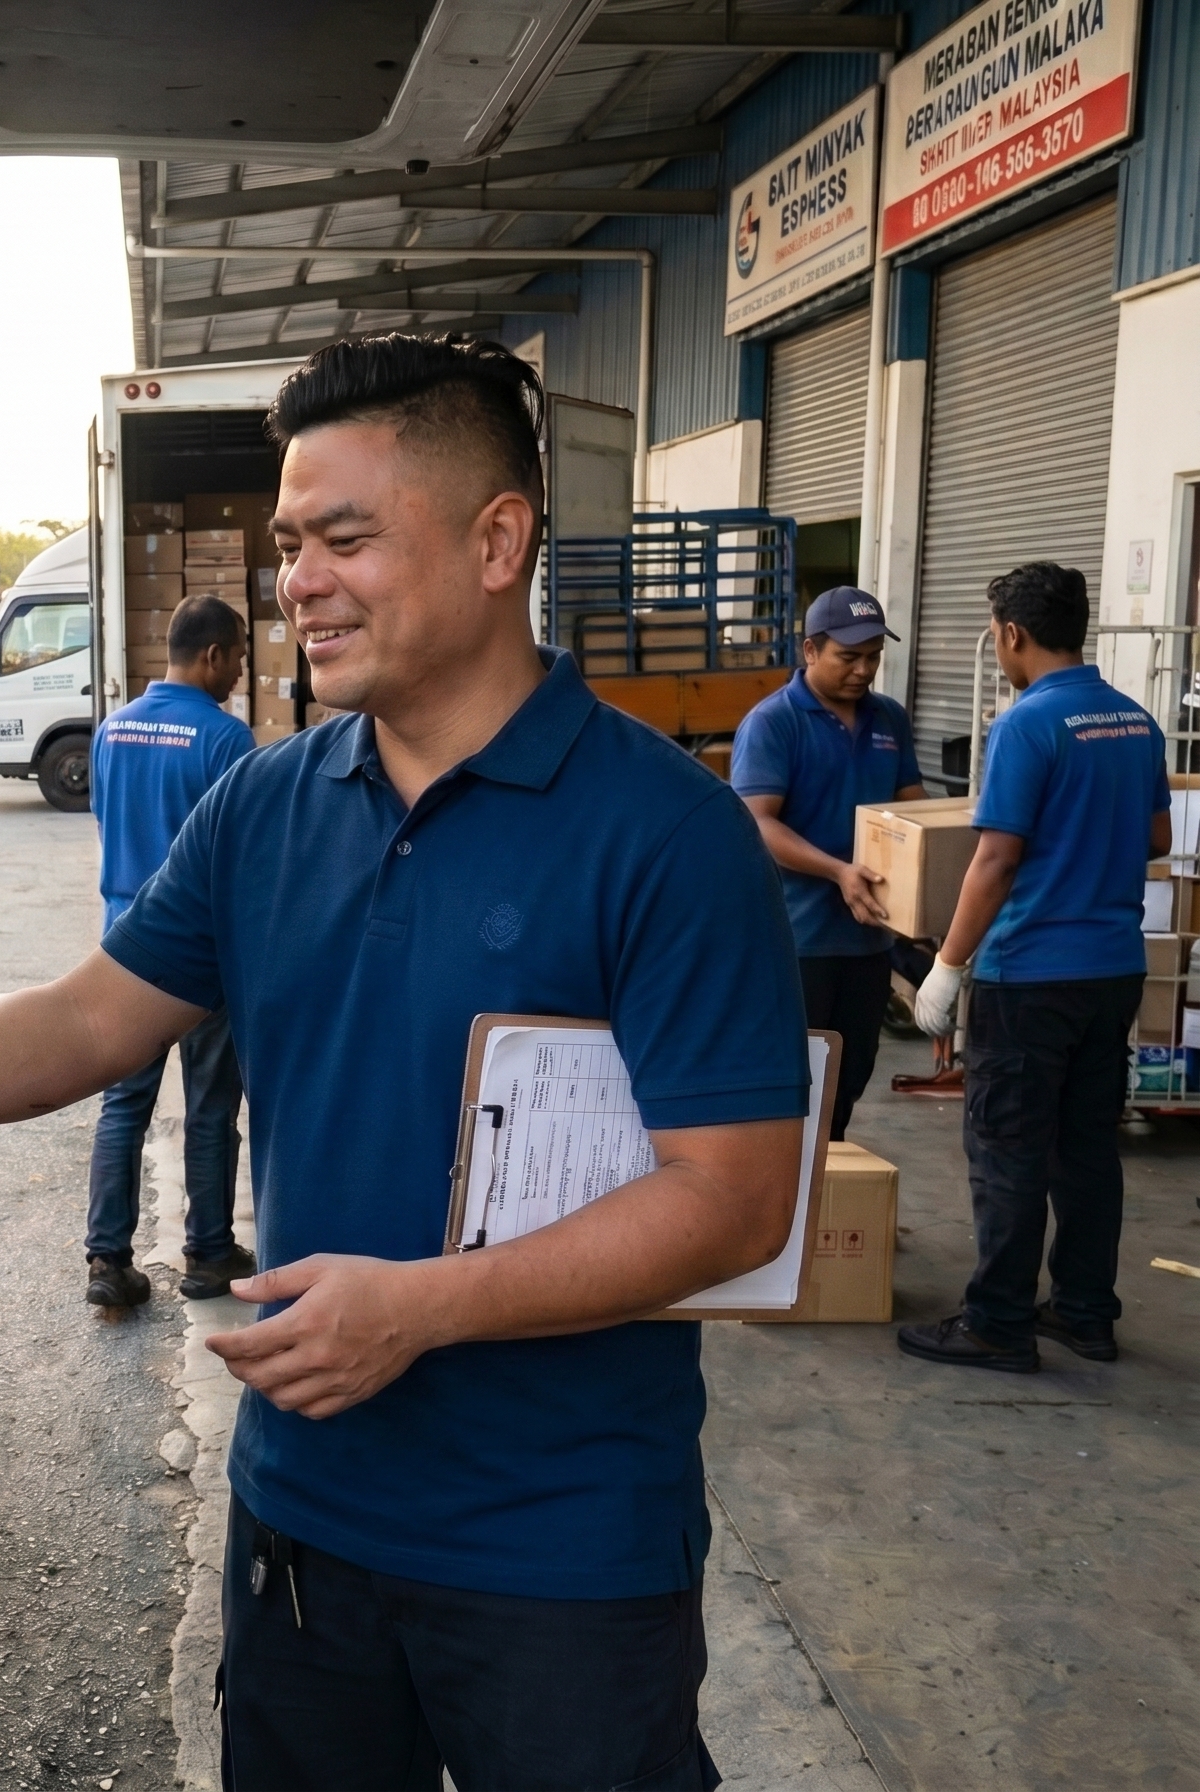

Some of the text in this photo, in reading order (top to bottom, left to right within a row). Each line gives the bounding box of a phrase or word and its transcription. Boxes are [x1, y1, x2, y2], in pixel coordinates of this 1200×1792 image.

[924, 10, 1000, 95] MERABAN
[1024, 0, 1104, 77] MALAKA
[999, 58, 1081, 132] MALAYSIA
[805, 108, 867, 184] MINYAK
[781, 168, 847, 239] ESPHESS
